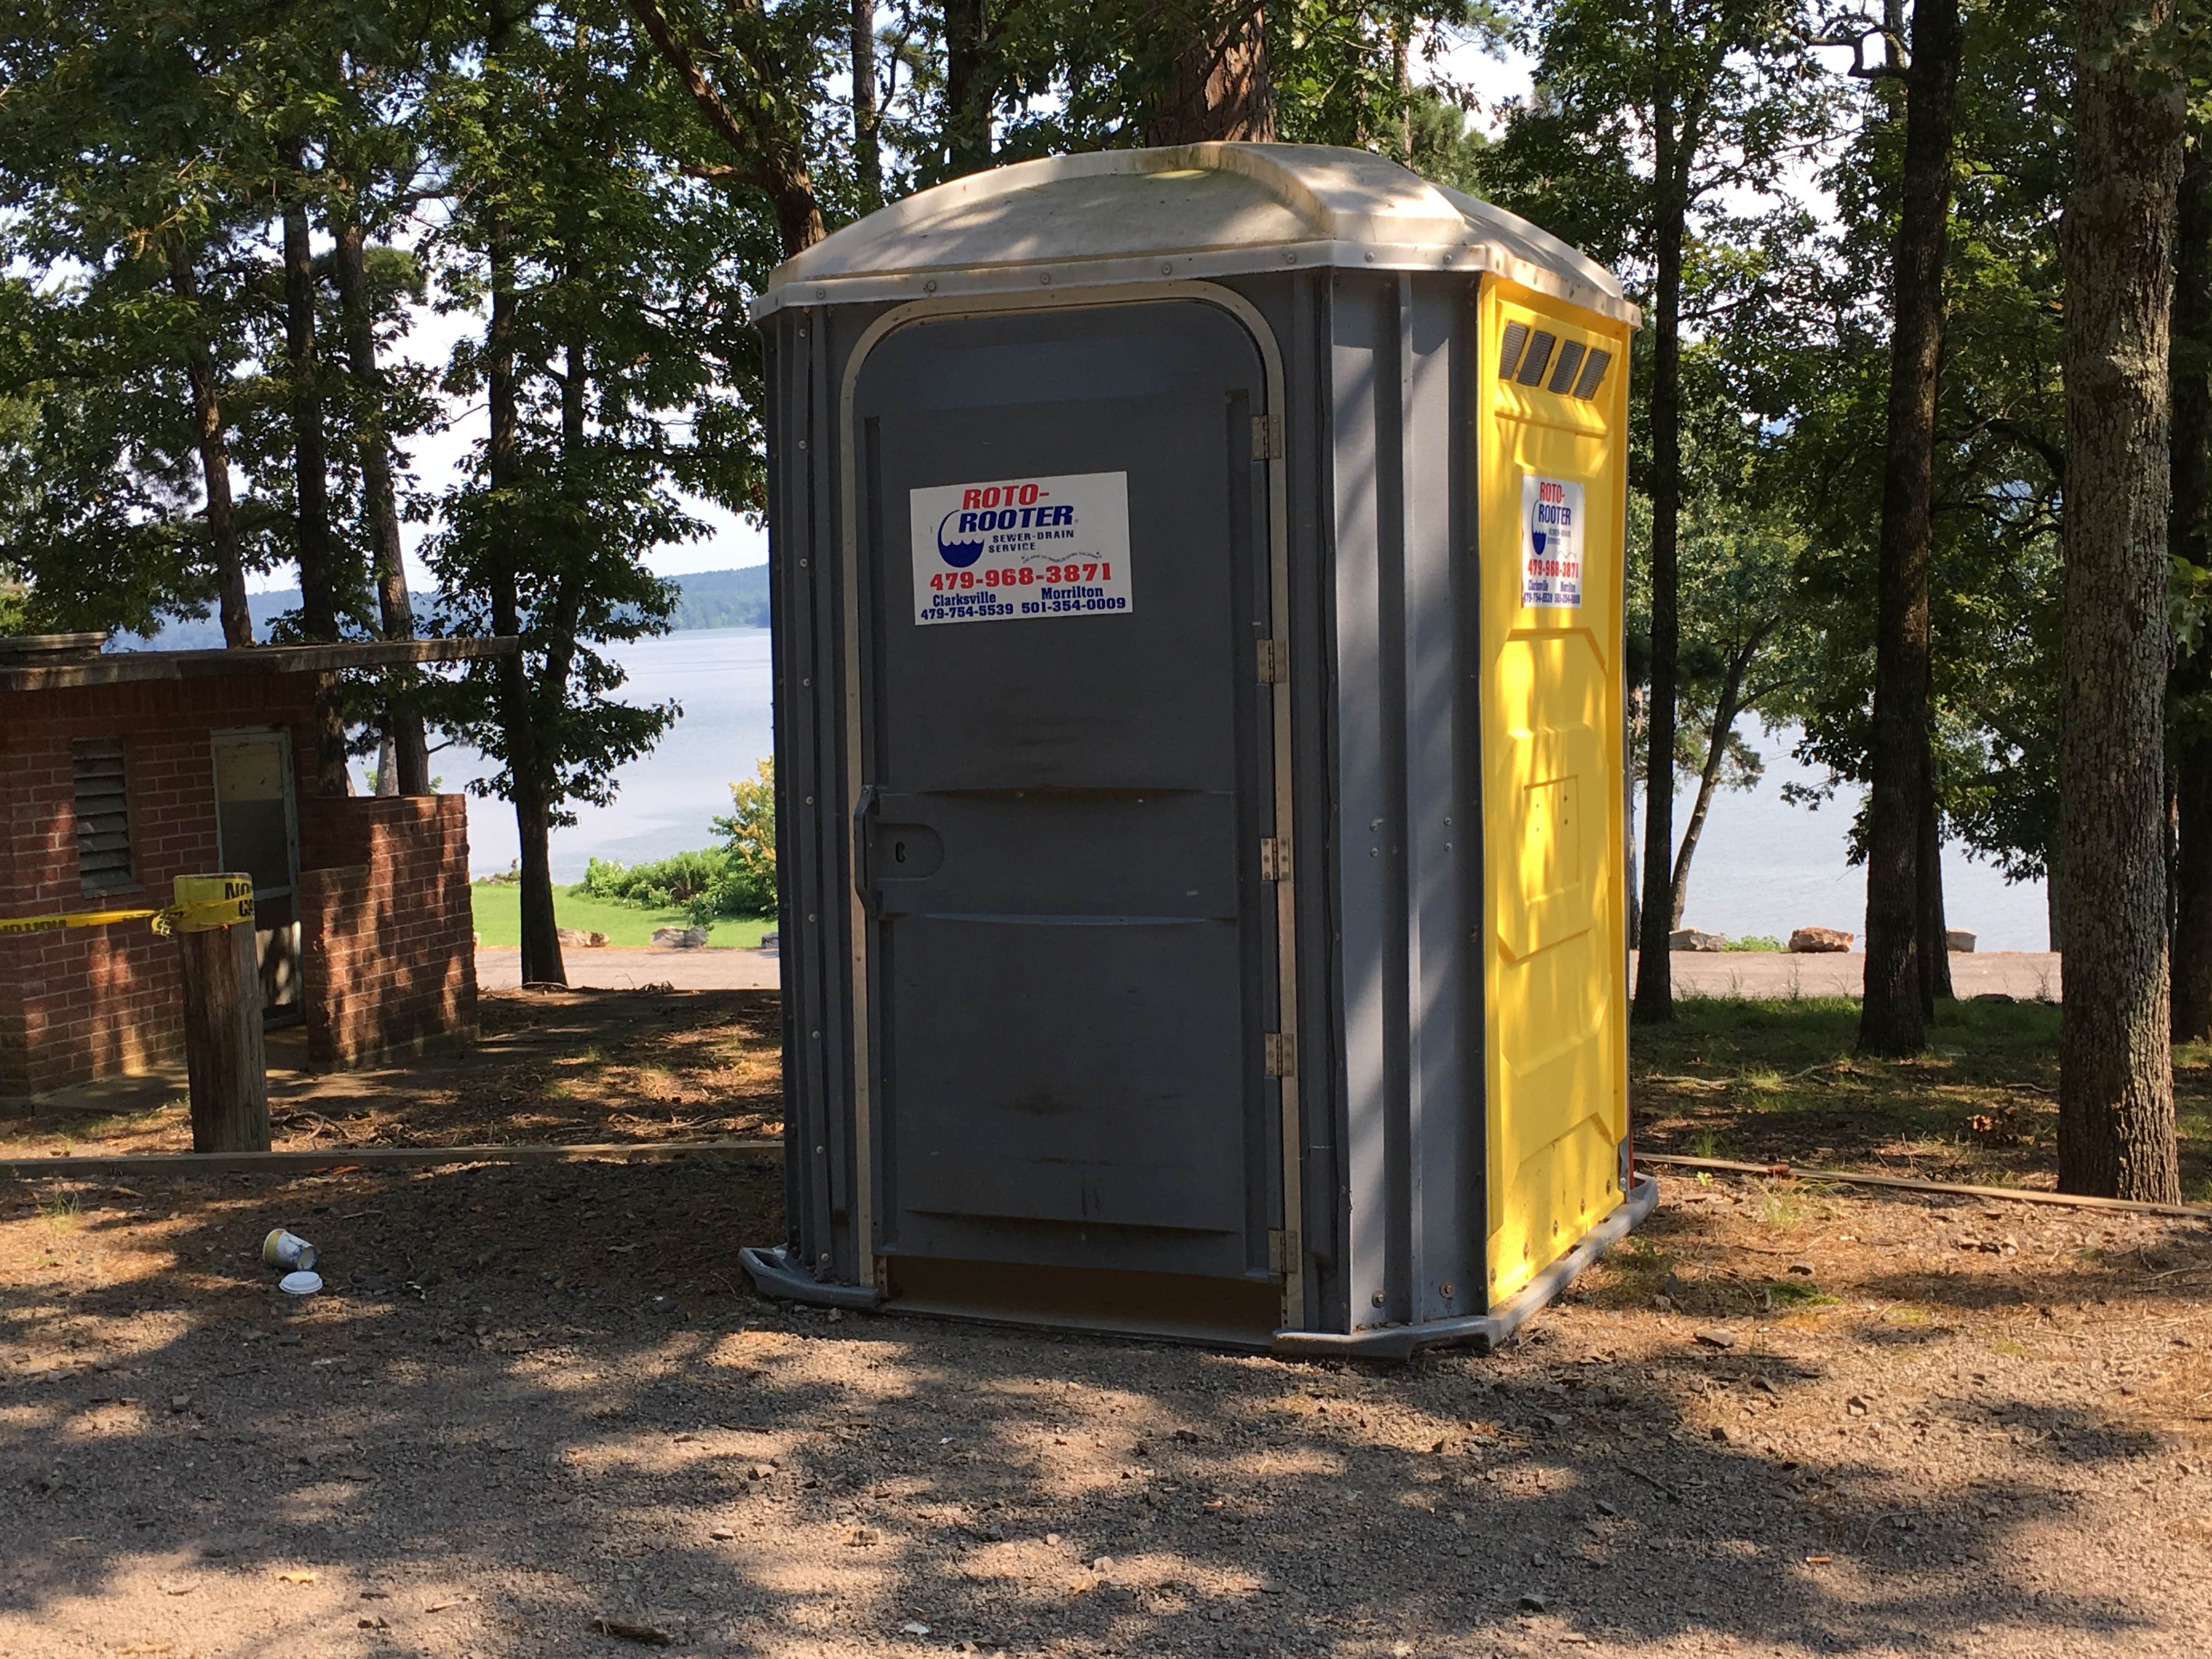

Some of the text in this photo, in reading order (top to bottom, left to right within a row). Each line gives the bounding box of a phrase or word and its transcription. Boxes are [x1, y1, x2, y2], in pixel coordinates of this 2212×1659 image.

[963, 484, 1049, 510] ROTO-
[1539, 482, 1565, 503] ROTO-
[958, 505, 1074, 533] ROOTER
[1538, 504, 1571, 526] ROOTER
[992, 530, 1074, 543] SEWER-DRAIN
[989, 542, 1036, 553] SERVICE
[930, 562, 1111, 591] 479-968-3871
[1528, 558, 1578, 578] 479-968-3871
[933, 592, 996, 607] Clarksville
[1041, 586, 1104, 600] Morrilton
[921, 603, 1014, 620] 479-754-5539
[1022, 597, 1126, 613] 501-354-0009
